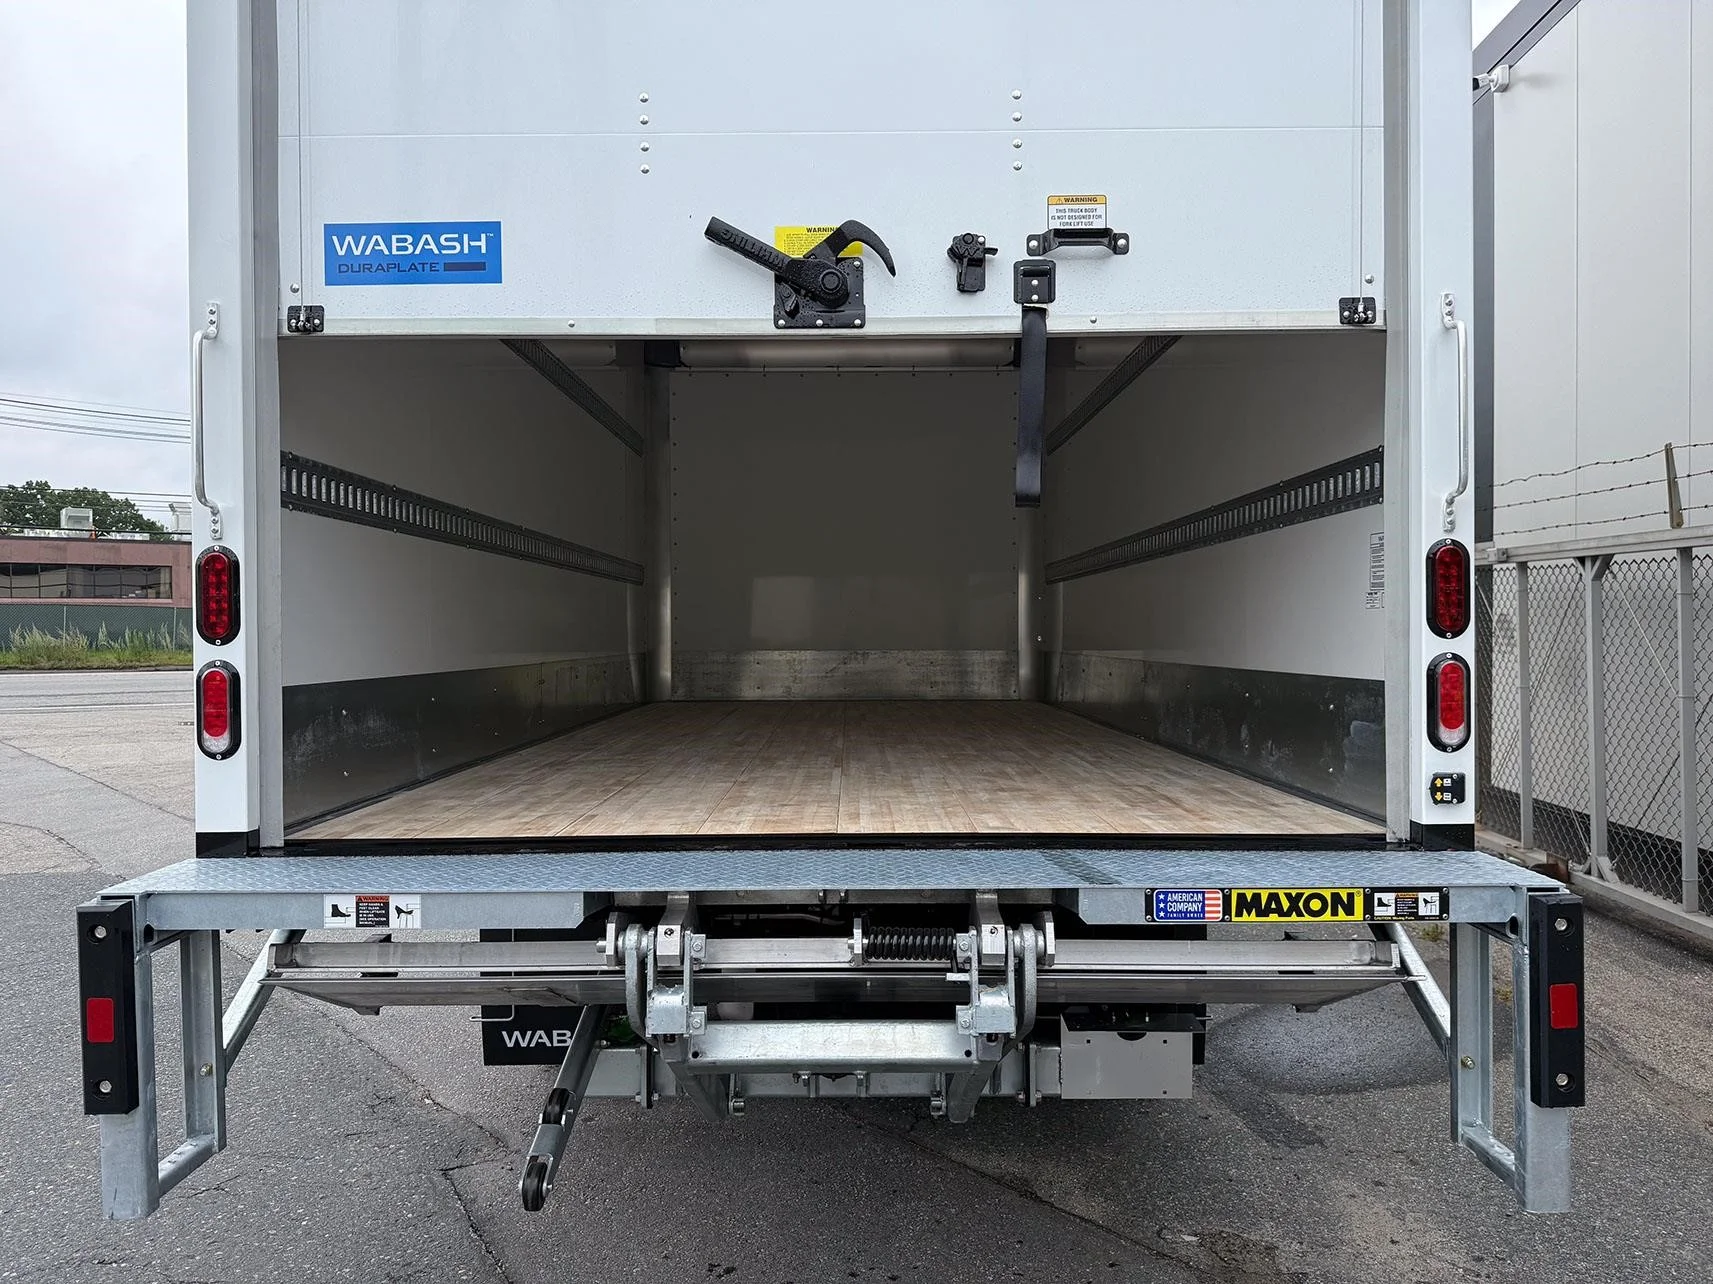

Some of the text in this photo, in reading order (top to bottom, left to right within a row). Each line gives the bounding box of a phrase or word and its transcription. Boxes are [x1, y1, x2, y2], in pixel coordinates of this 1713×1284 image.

[332, 233, 487, 256] WABASH
[338, 262, 439, 274] DURAPLATE
[1167, 892, 1203, 902] AMERICAN
[1167, 902, 1203, 912] COMPANY
[1235, 892, 1355, 917] MAXON
